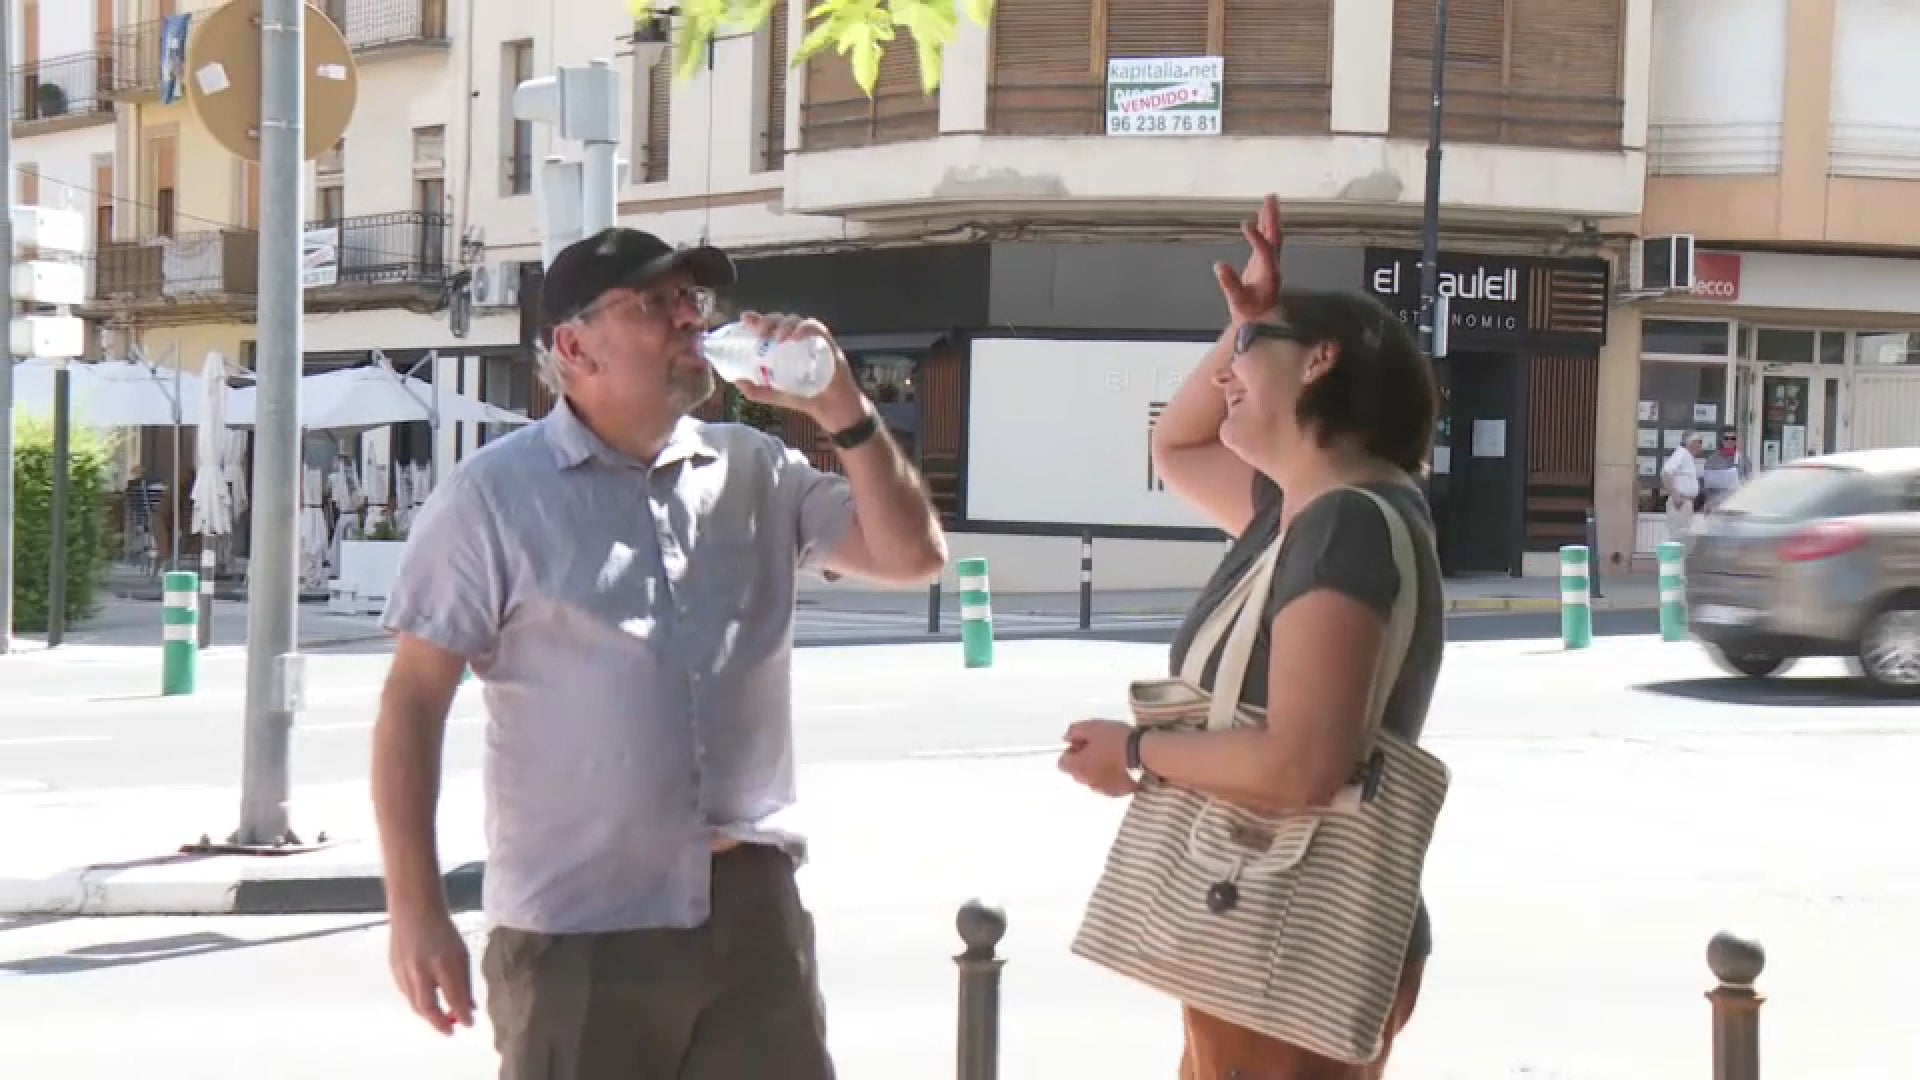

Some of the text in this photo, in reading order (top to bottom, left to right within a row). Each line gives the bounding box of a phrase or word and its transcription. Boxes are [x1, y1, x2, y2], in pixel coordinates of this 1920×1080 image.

[1110, 62, 1217, 81] kapitalia.net
[1121, 89, 1188, 113] VENDIDO
[1110, 116, 1217, 132] 96 238 76 81
[1415, 261, 1517, 302] aulell
